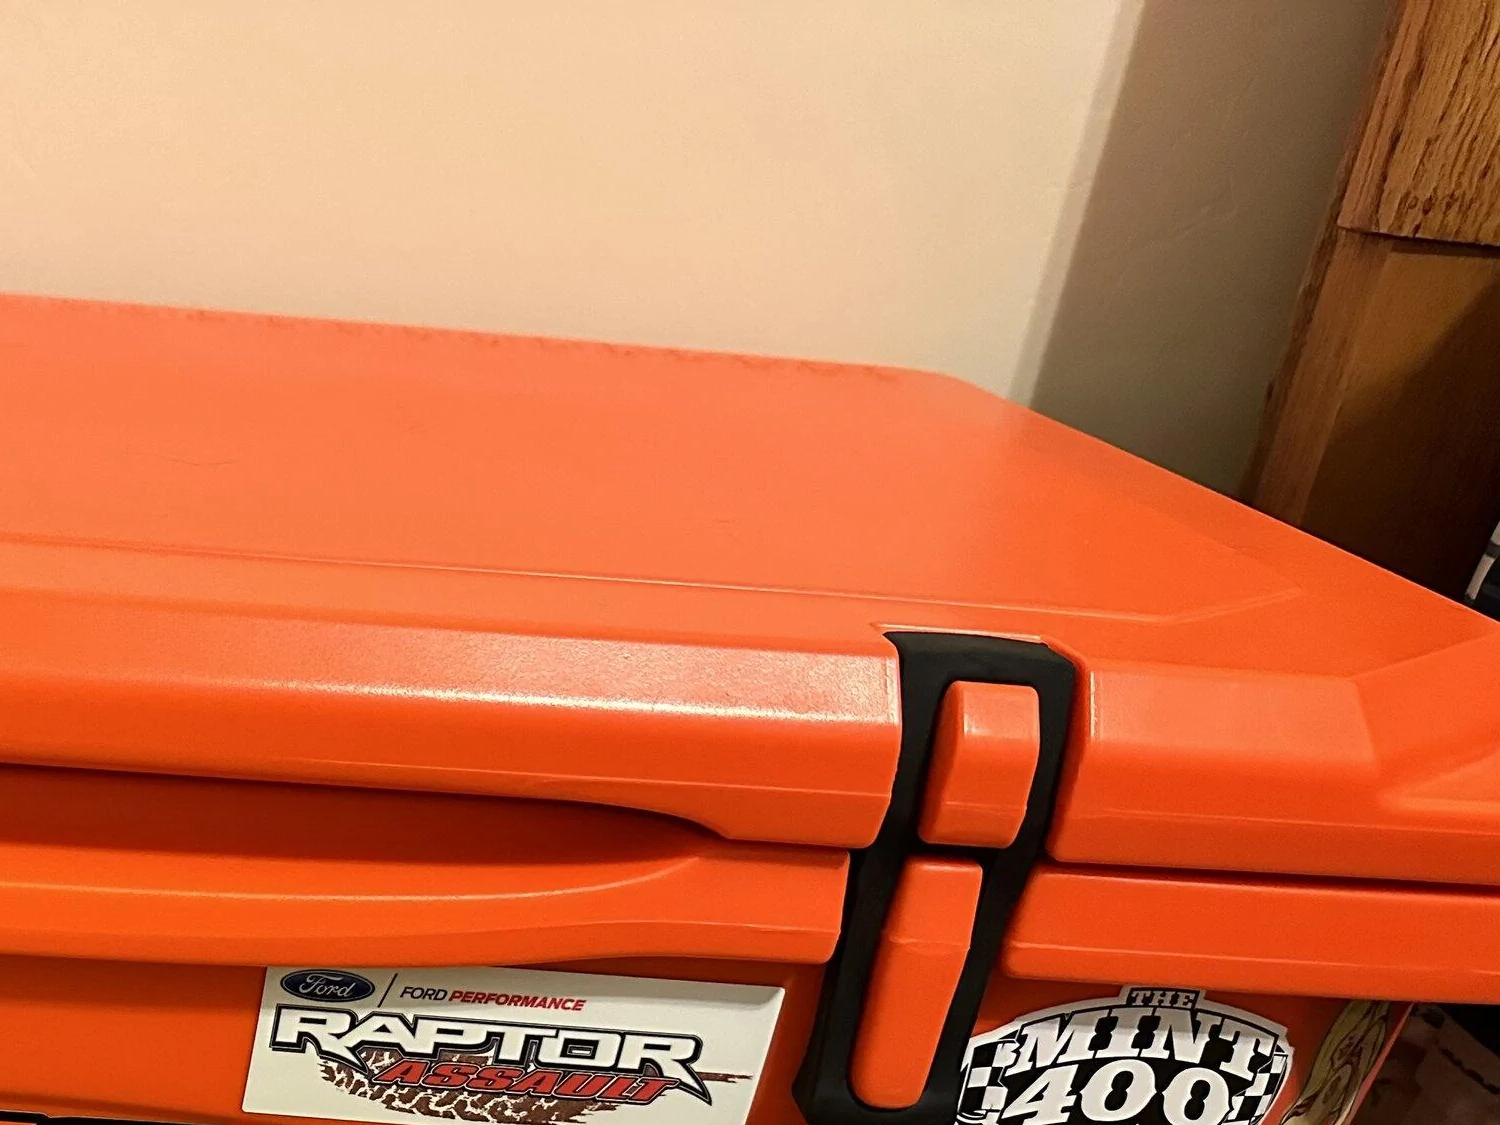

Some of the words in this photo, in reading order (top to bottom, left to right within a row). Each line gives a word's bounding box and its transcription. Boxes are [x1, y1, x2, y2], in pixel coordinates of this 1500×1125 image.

[299, 972, 357, 998] Ford
[400, 986, 448, 1002] FORD
[448, 989, 586, 1012] PERFORMANCE
[1130, 989, 1197, 1010] THE
[271, 1005, 712, 1104] RAPTOR
[1004, 1006, 1274, 1081] MINT
[372, 1058, 684, 1103] ASSAULT
